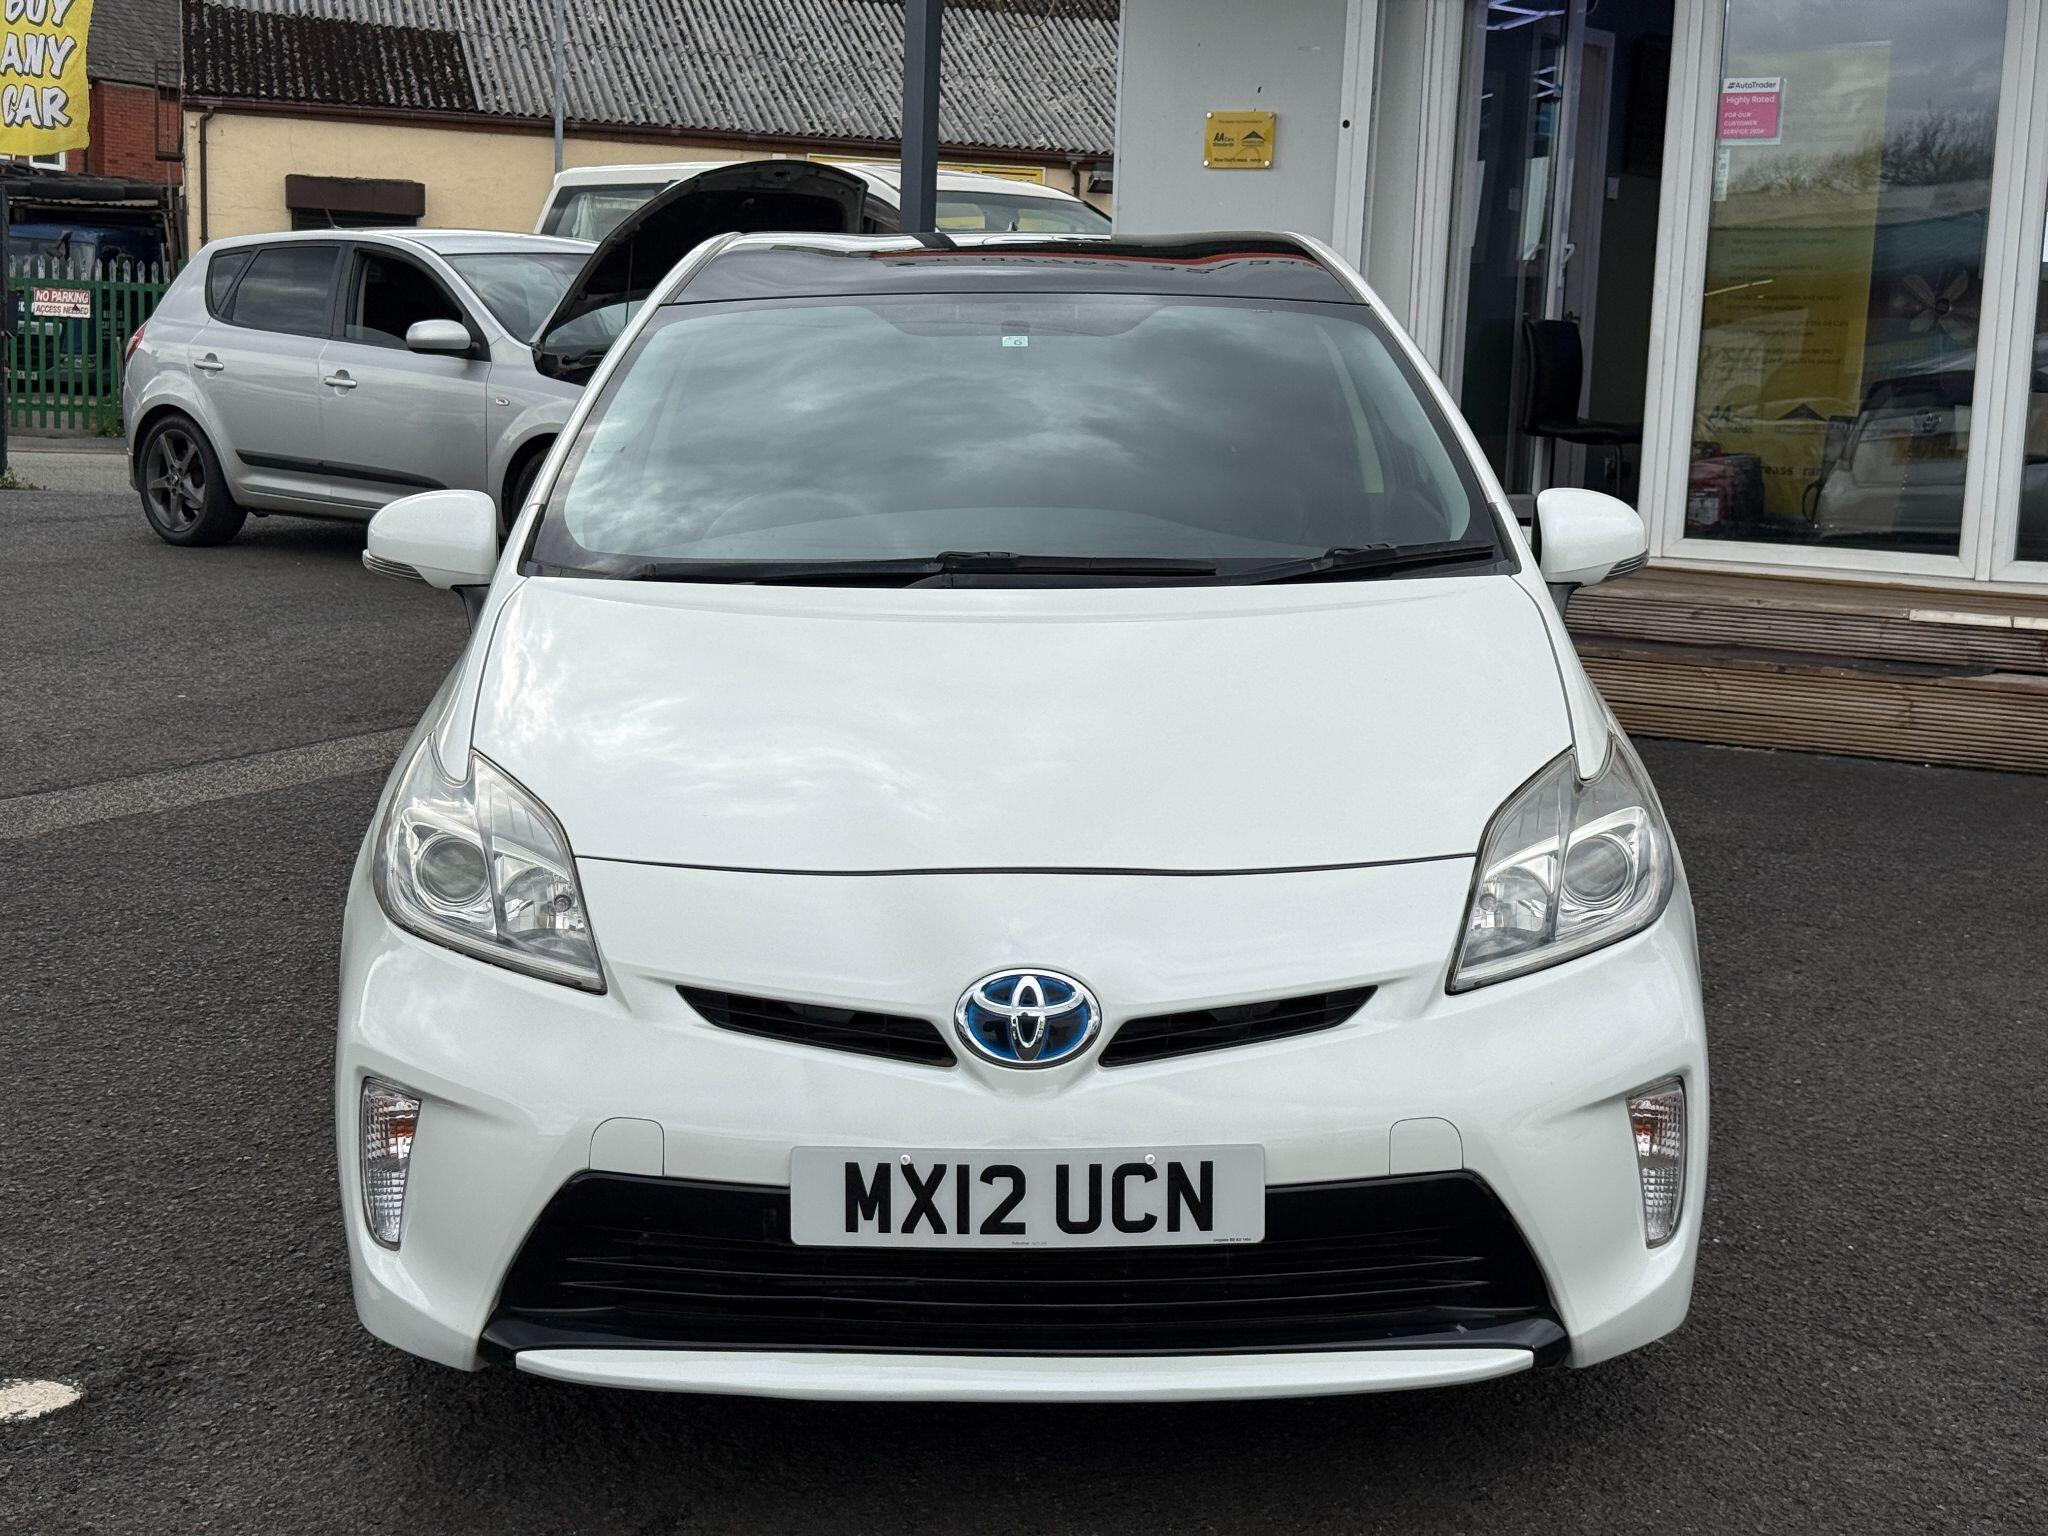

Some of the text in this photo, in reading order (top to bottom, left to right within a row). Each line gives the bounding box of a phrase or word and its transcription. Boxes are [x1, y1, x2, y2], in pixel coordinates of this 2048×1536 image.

[0, 31, 77, 79] ANY
[1735, 81, 1777, 89] AutoTrader
[2, 84, 72, 129] CAR
[1726, 95, 1775, 105] Highly Rated
[35, 290, 89, 304] NO PARKING
[36, 304, 62, 314] ACCESS
[845, 1160, 1214, 1235] MX12 UCN
